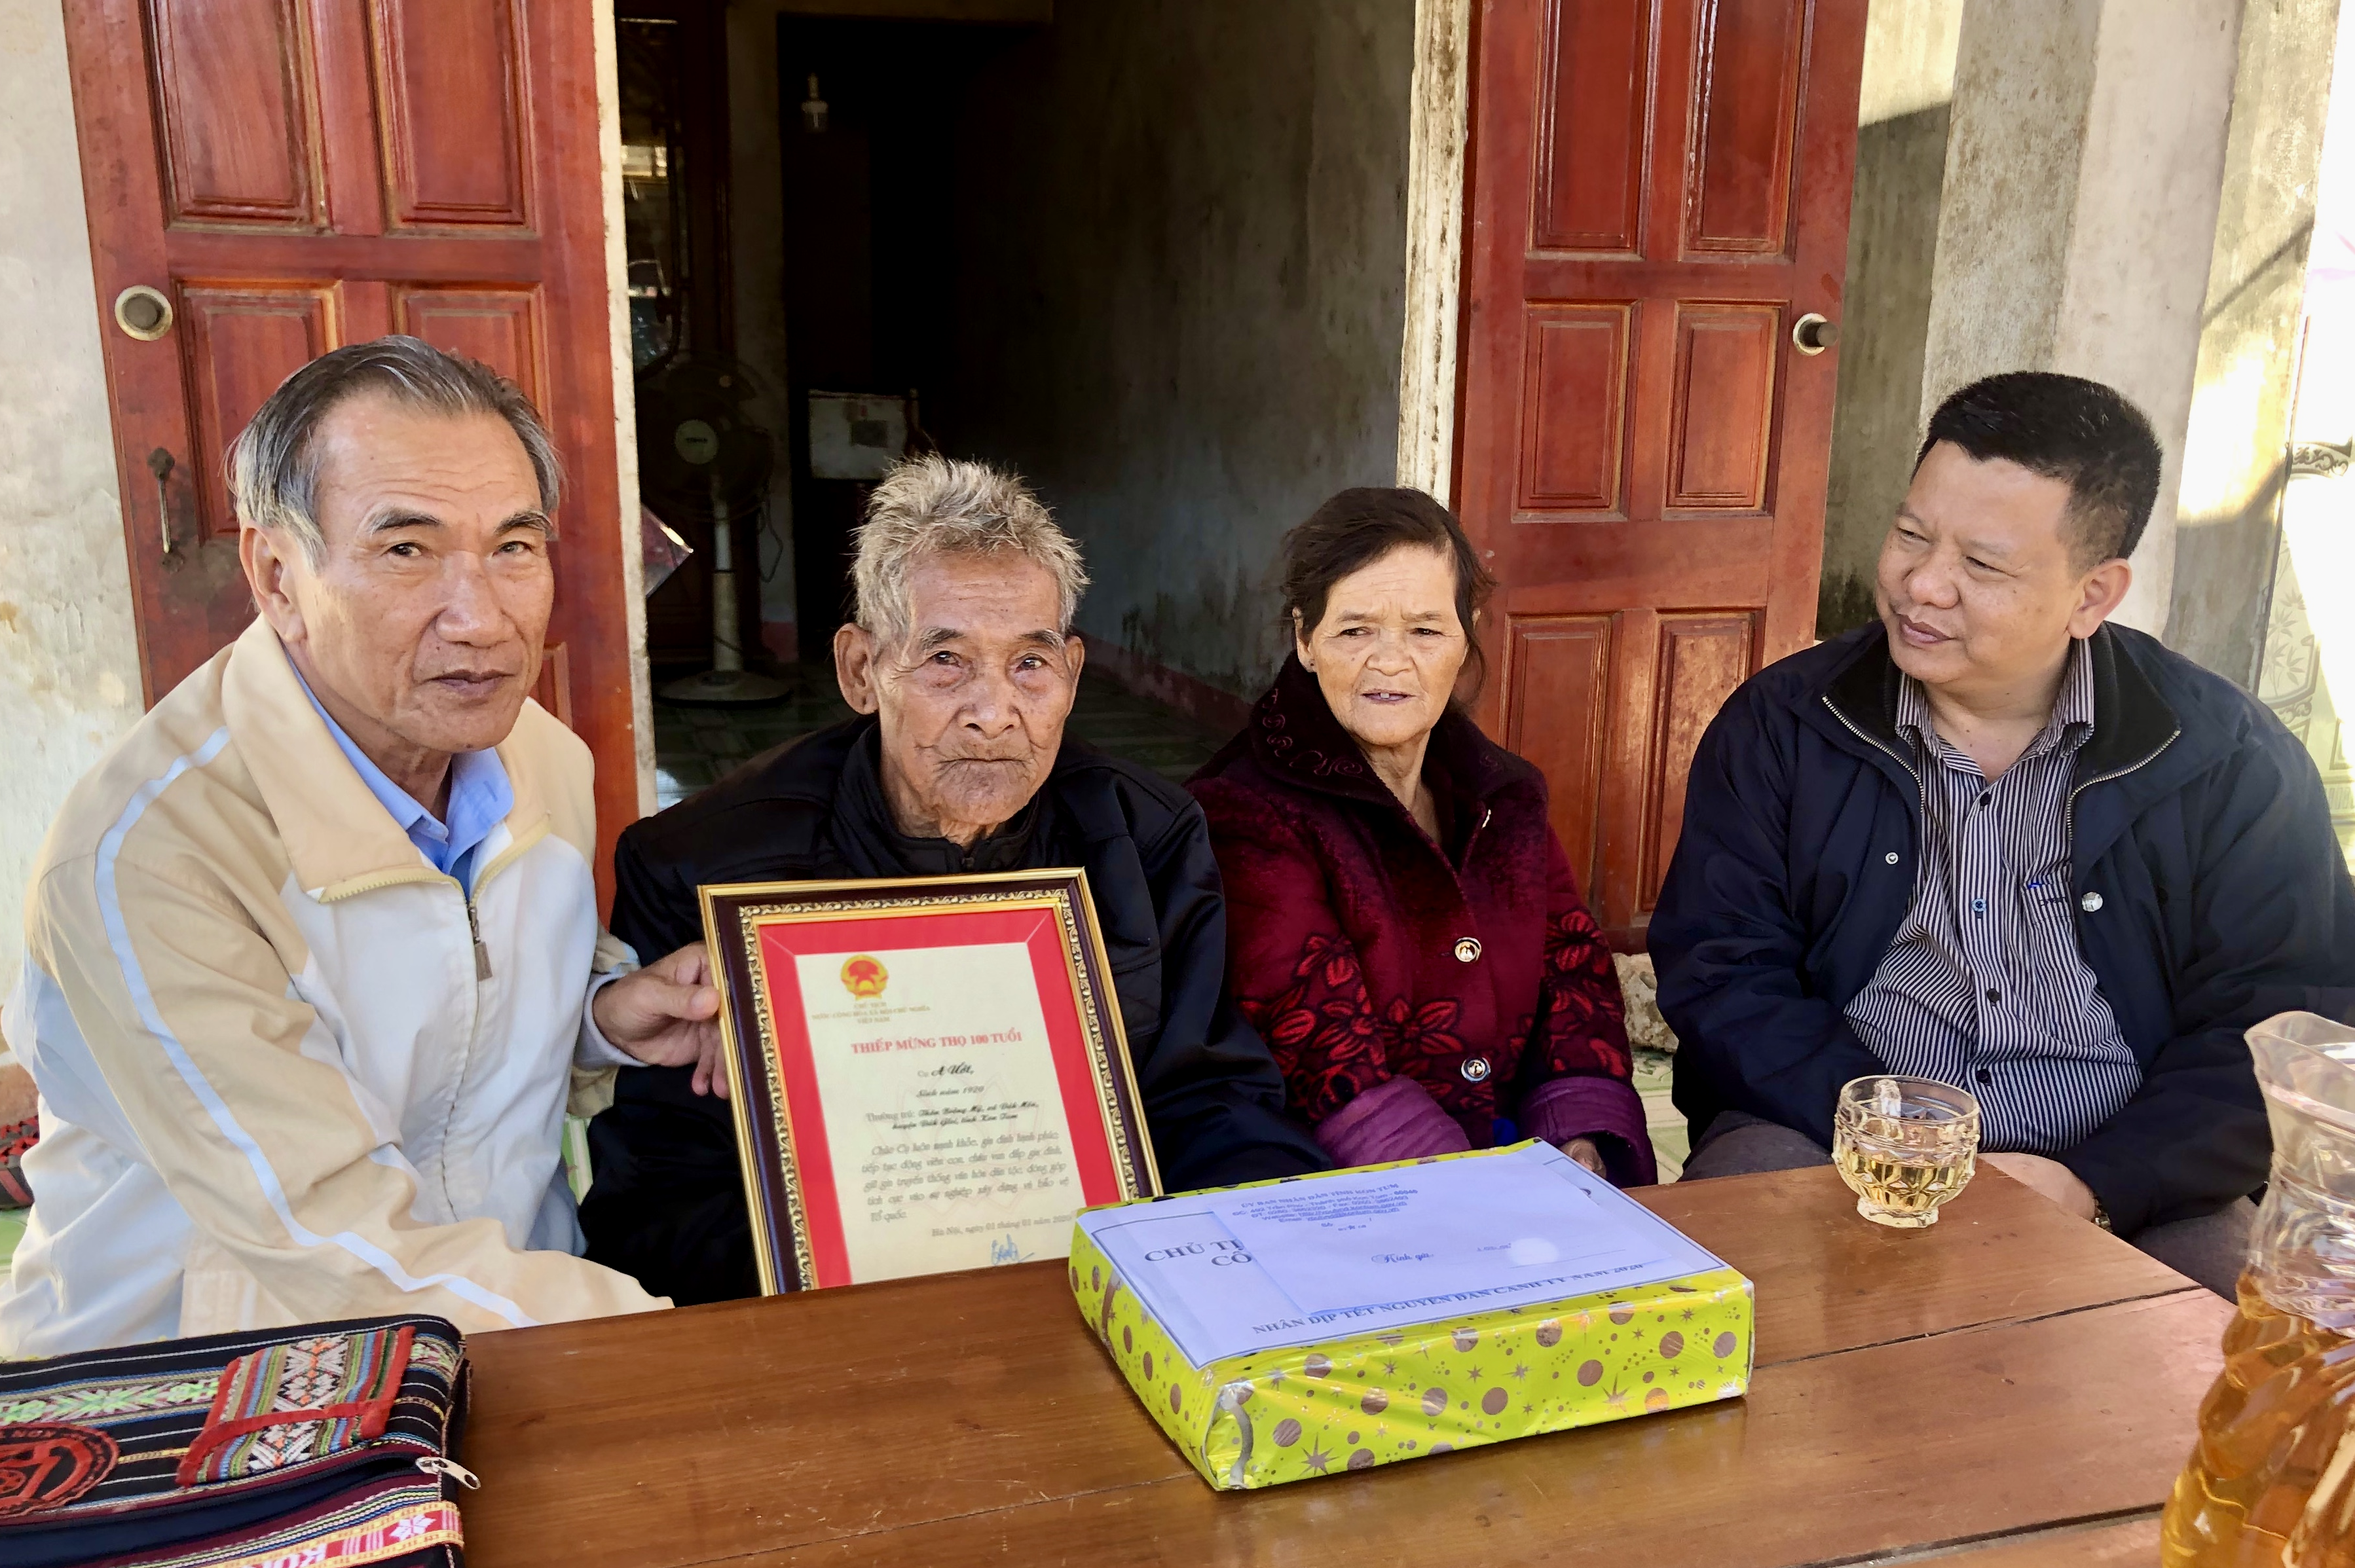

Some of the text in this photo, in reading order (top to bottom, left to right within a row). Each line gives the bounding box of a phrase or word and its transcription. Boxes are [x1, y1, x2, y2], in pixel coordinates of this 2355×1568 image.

[851, 1027, 1022, 1054] THIẾP MỪNG THỌ 100 TUỔI
[1144, 1241, 1206, 1262] CHỦ
[1252, 1317, 1306, 1334] NHÂN
[1308, 1313, 1337, 1324] DỊP
